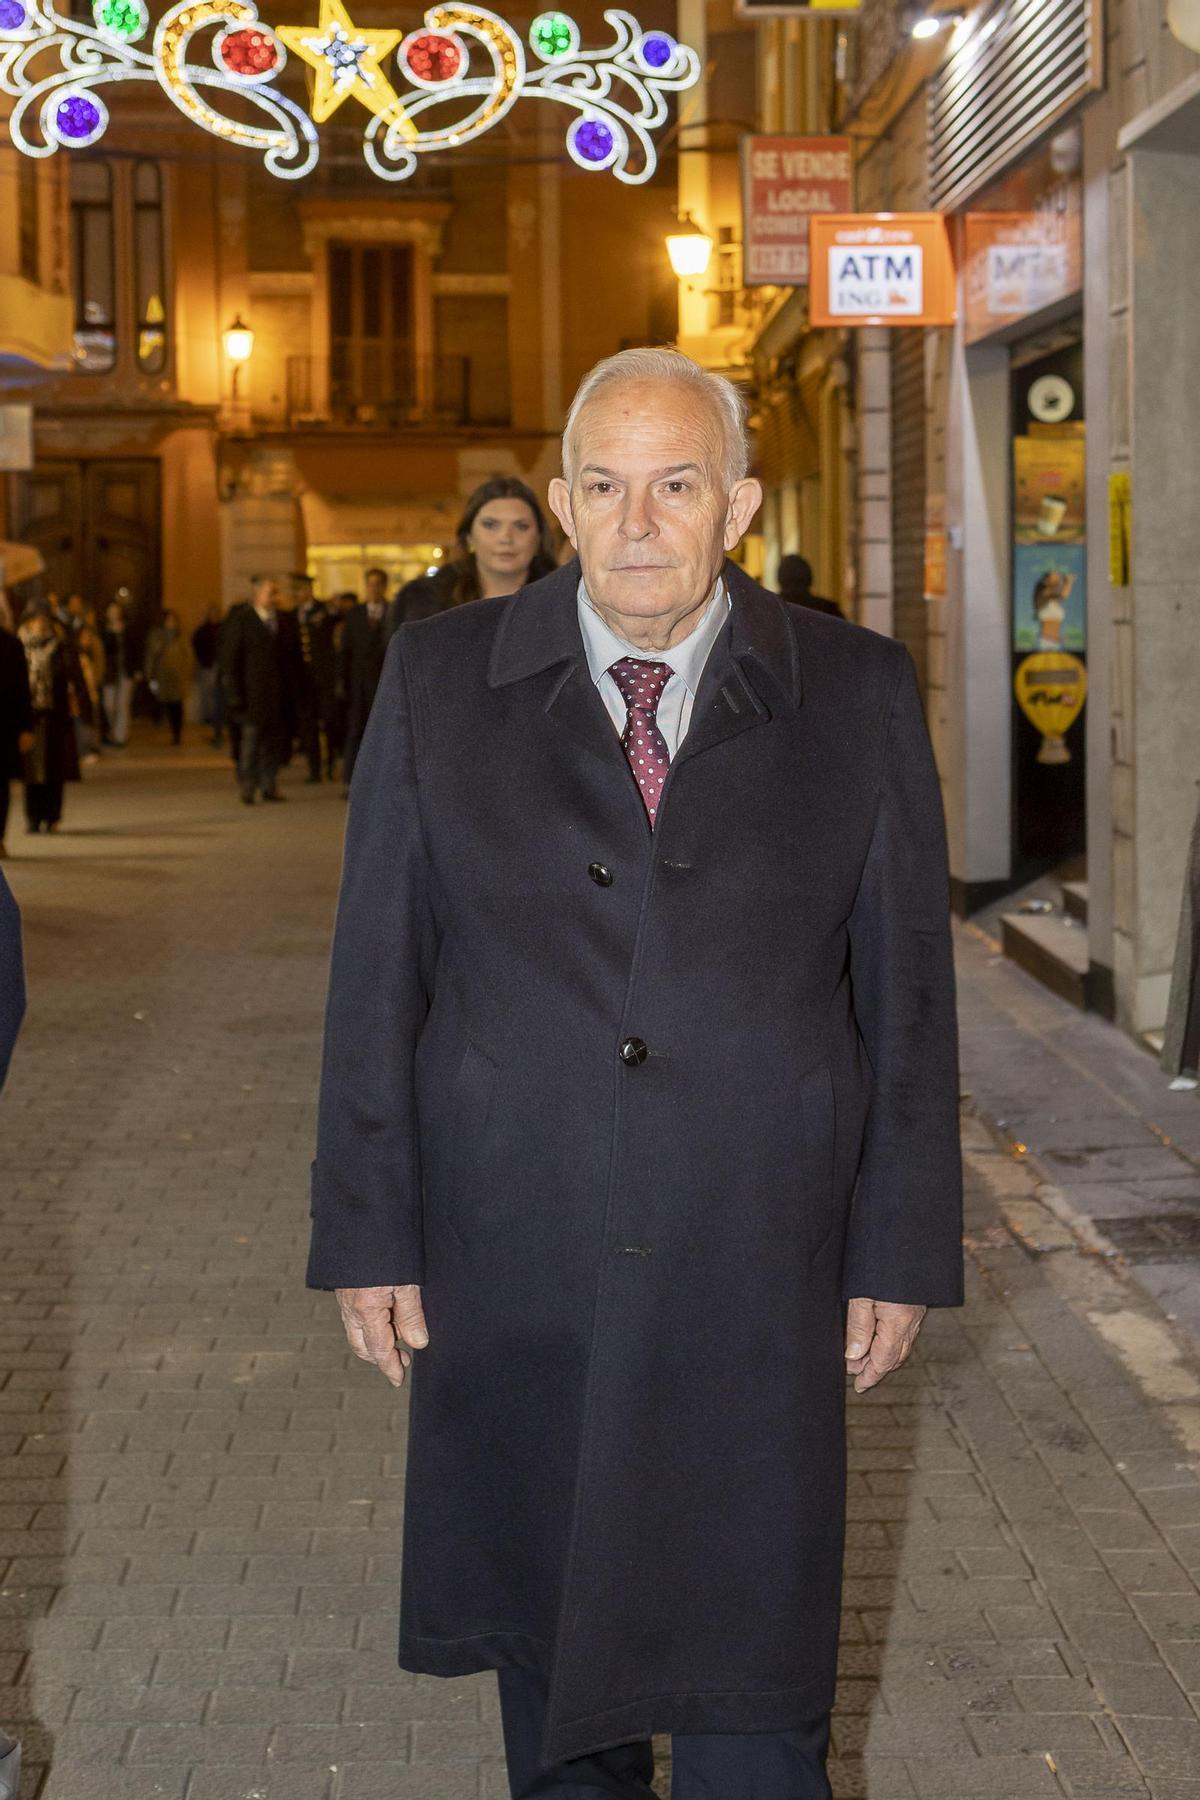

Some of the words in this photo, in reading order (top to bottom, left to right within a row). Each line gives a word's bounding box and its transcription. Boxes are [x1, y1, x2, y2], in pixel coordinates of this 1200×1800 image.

[753, 151, 778, 179] SE
[783, 151, 849, 179] VENDE
[767, 188, 835, 212] LOCAL
[839, 255, 913, 280] ATM
[838, 291, 881, 308] ING
